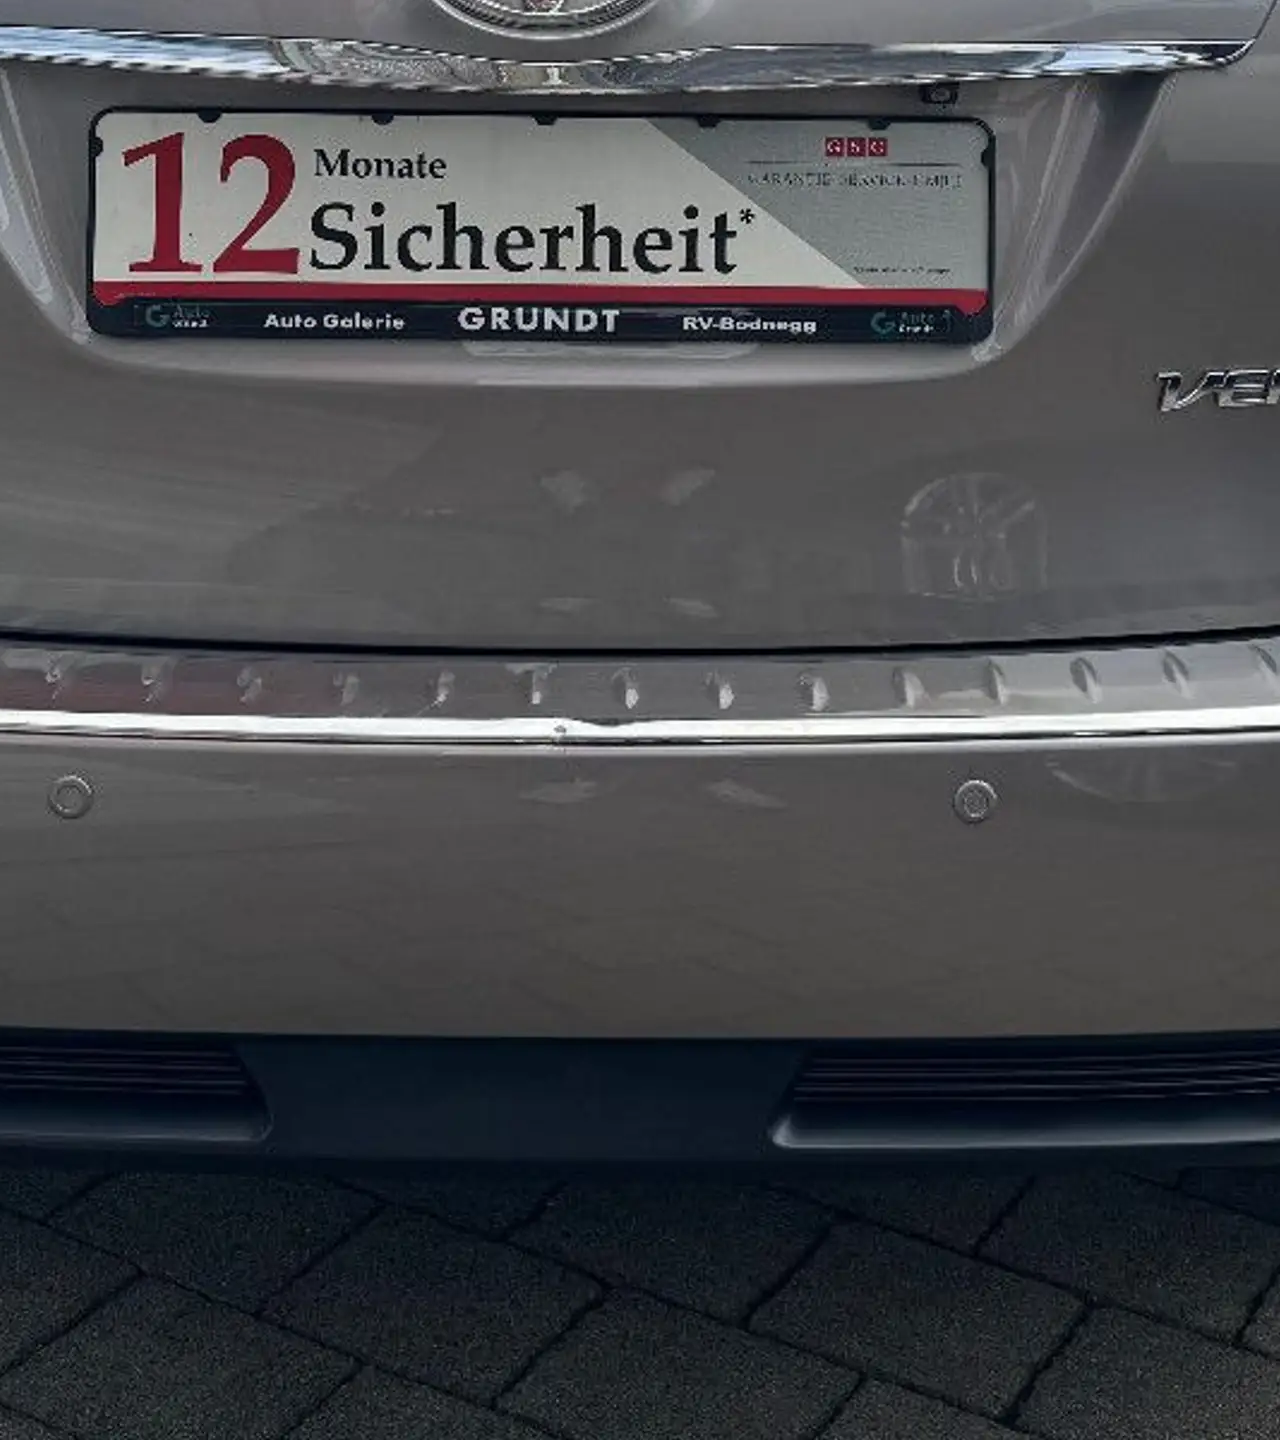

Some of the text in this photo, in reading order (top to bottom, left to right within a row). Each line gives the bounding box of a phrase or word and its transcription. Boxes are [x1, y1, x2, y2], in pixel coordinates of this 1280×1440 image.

[313, 148, 447, 179] Monate
[122, 132, 300, 274] 12
[264, 312, 406, 331] Auto Galerie
[457, 306, 620, 333] GRUNDT
